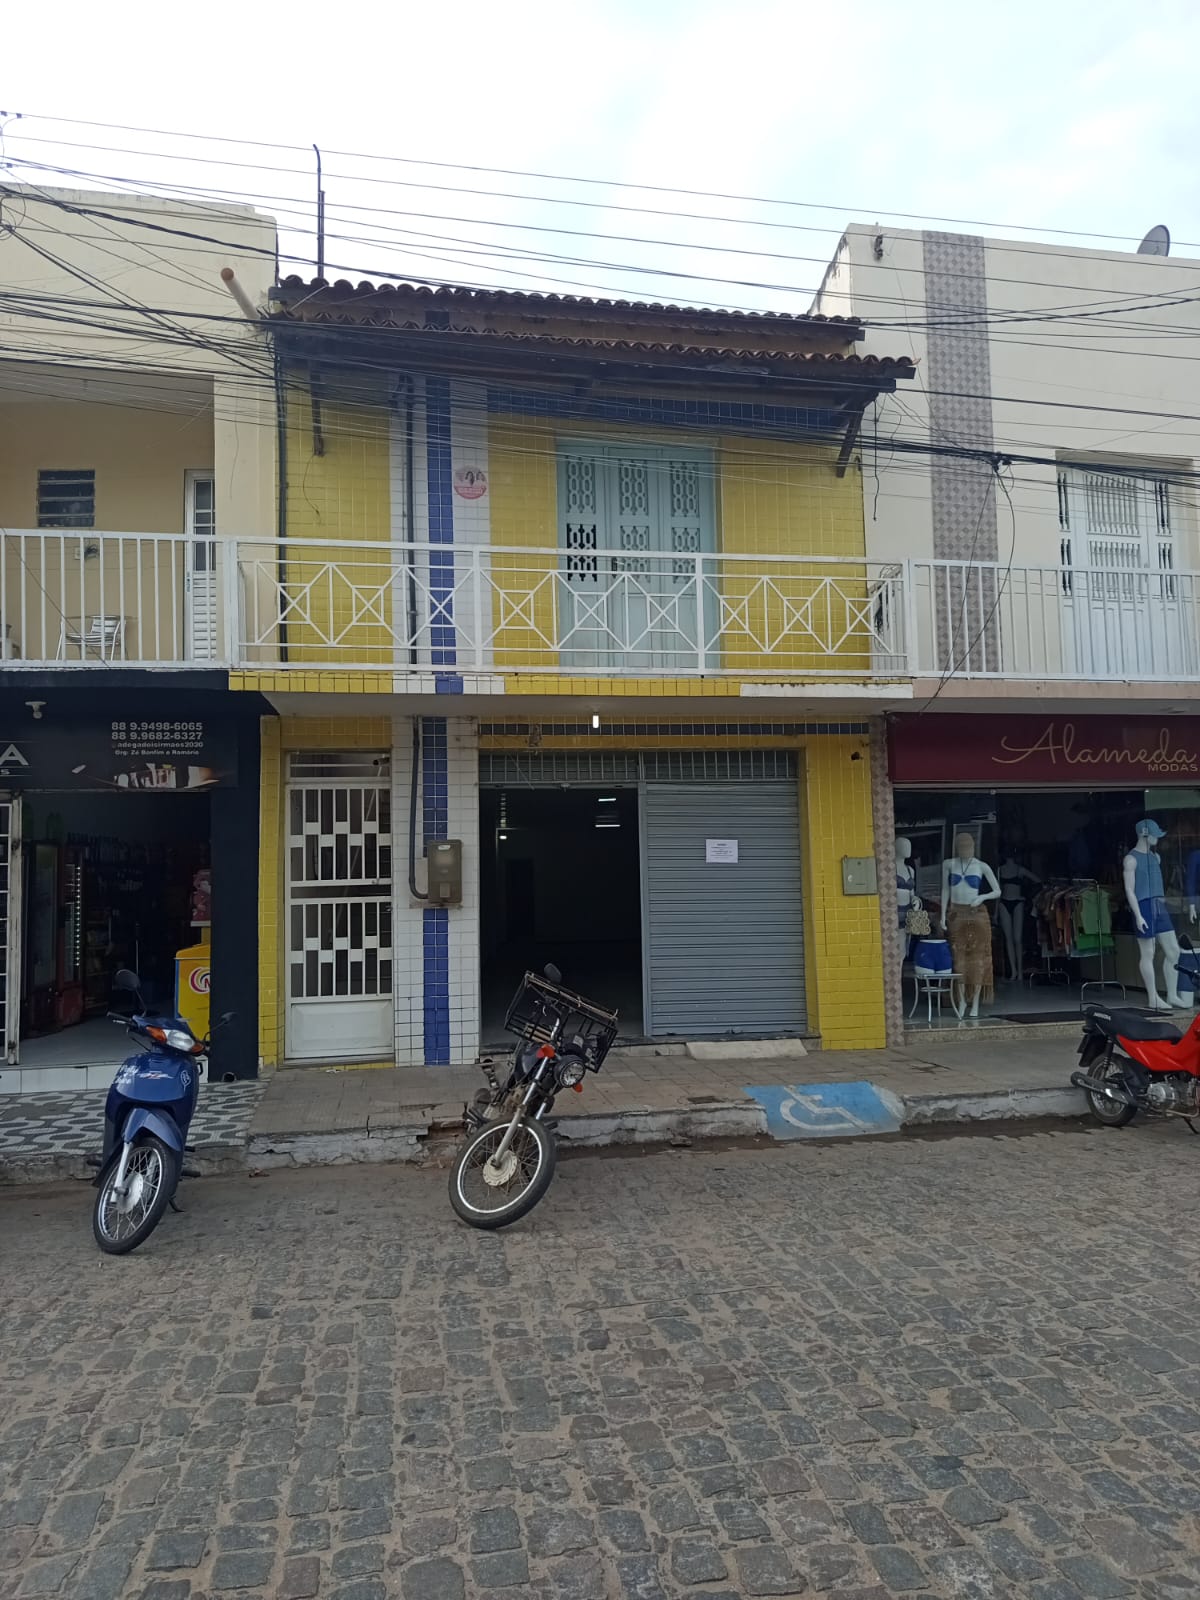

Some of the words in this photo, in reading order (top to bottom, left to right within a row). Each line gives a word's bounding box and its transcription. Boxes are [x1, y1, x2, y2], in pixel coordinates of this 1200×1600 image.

[111, 721, 127, 731] 88
[129, 721, 203, 731] 9.9498-6065
[111, 731, 127, 740] 88
[129, 731, 203, 740] 9.9682-6327
[991, 722, 1198, 764] Alameda
[1147, 763, 1199, 772] MODAS
